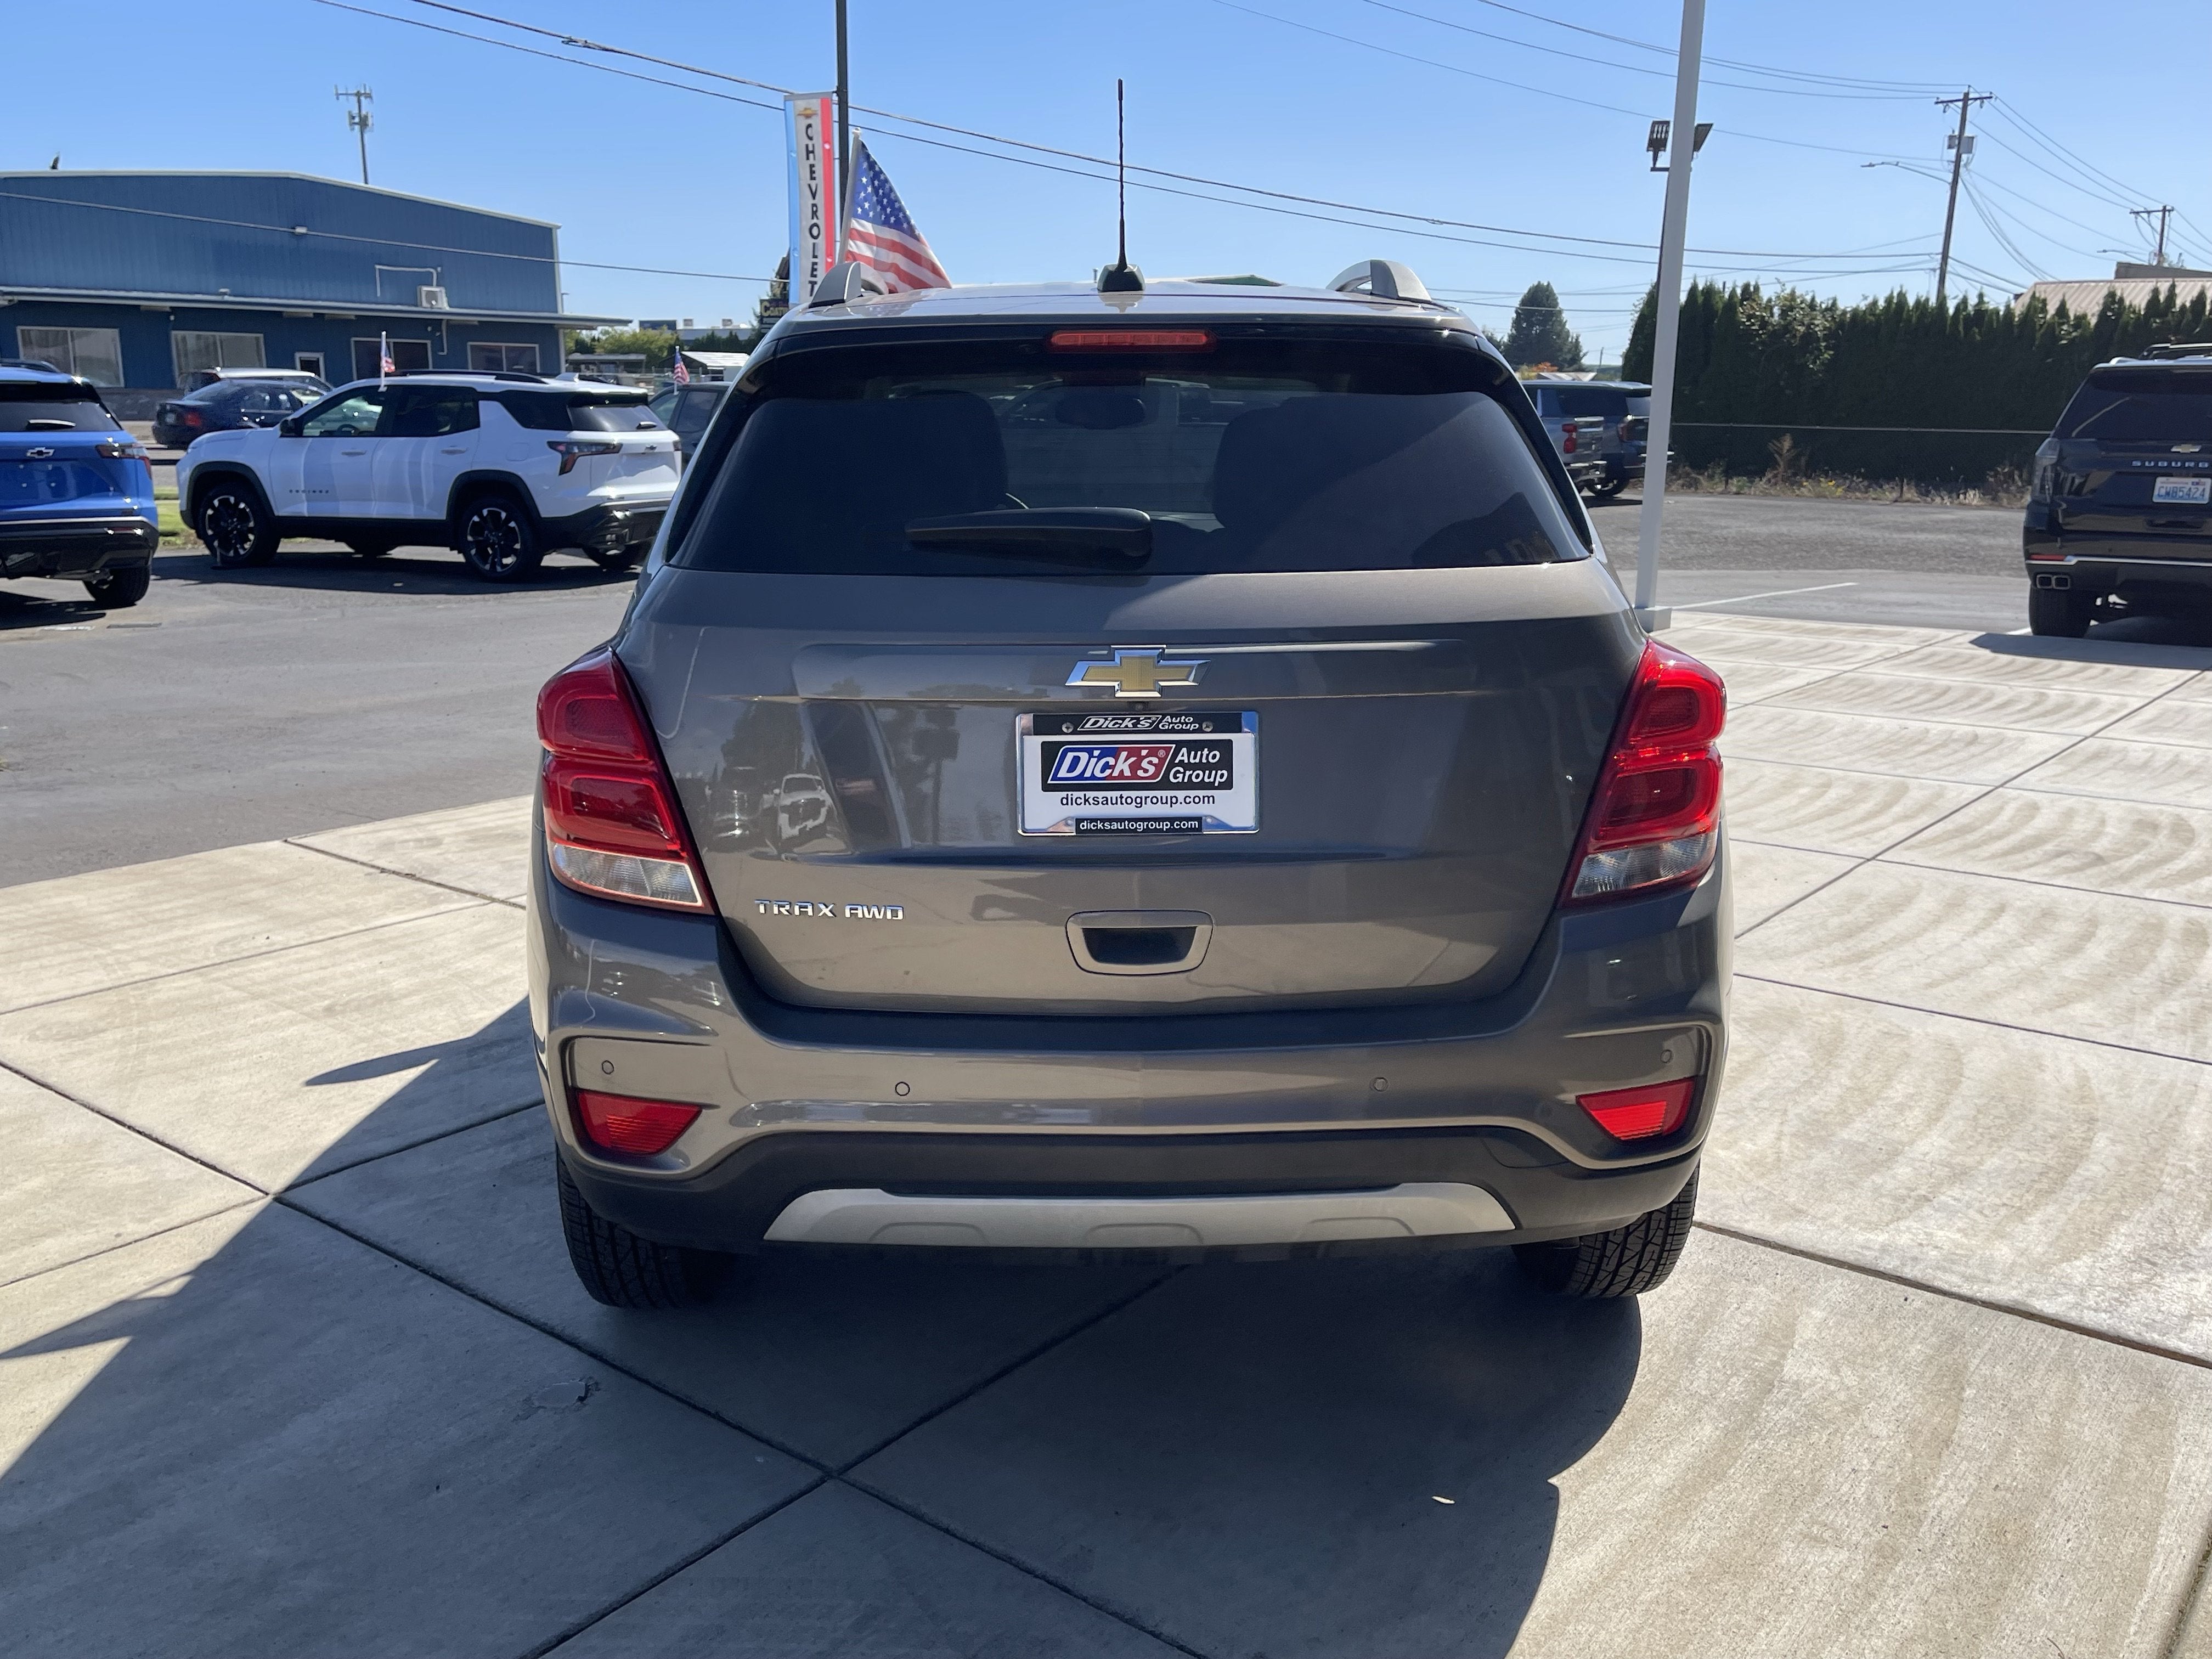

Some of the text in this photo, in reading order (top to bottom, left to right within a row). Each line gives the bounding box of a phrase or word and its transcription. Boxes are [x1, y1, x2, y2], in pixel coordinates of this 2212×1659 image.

[805, 123, 821, 297] CHEVROLET
[1159, 723, 1199, 731] Group
[1057, 747, 1220, 777] Dick's Auto
[1169, 767, 1228, 786] Group
[1060, 793, 1215, 808] dicksautogroup.com
[1080, 820, 1198, 831] dicksautogroup.com
[754, 899, 904, 920] TRAX AWD
